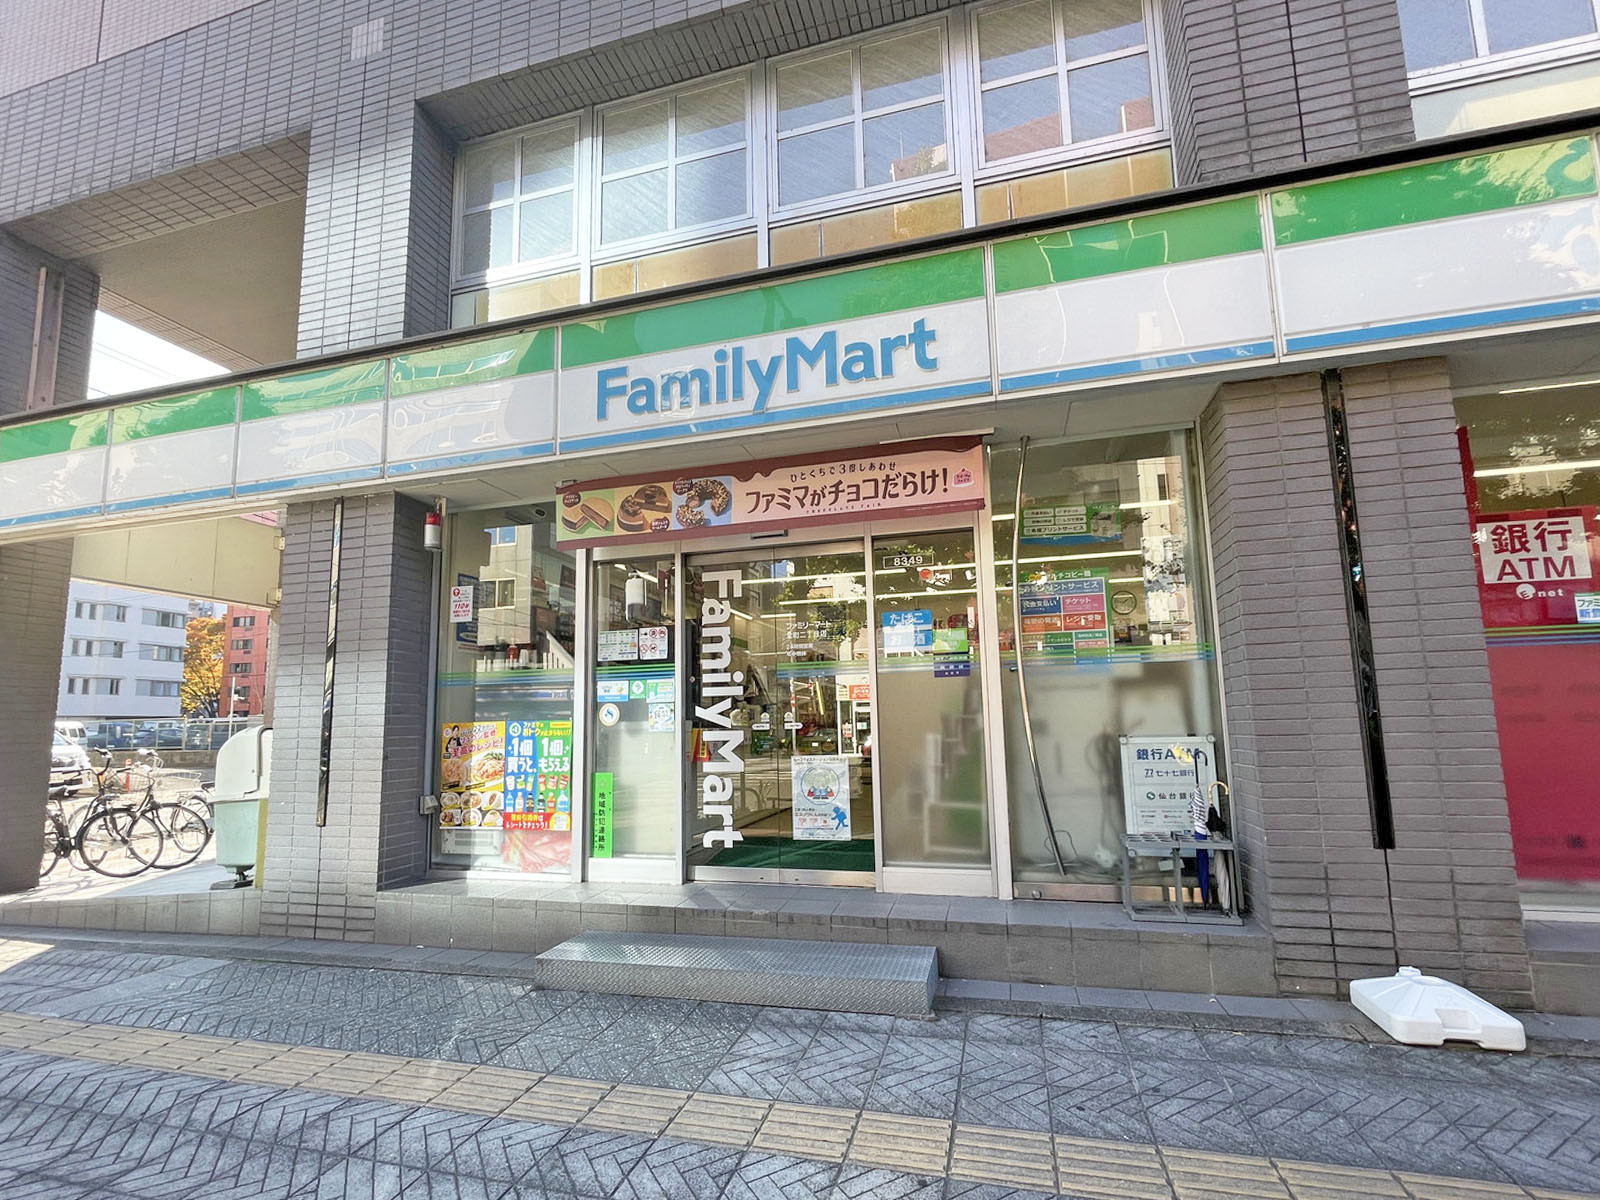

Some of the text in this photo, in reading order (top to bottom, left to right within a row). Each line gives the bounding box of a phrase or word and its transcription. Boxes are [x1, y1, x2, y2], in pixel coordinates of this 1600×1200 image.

[597, 318, 939, 421] FamilyMart
[746, 468, 948, 513] ファミマがチョコだらけ!
[1490, 521, 1572, 554] 銀行
[894, 556, 923, 566] 8349
[1497, 556, 1576, 581] ATM
[890, 612, 925, 625] たばこ
[695, 569, 745, 849] FamilyMart
[511, 737, 533, 756] 1個
[541, 737, 563, 756] 1個
[538, 757, 570, 772] もらえる
